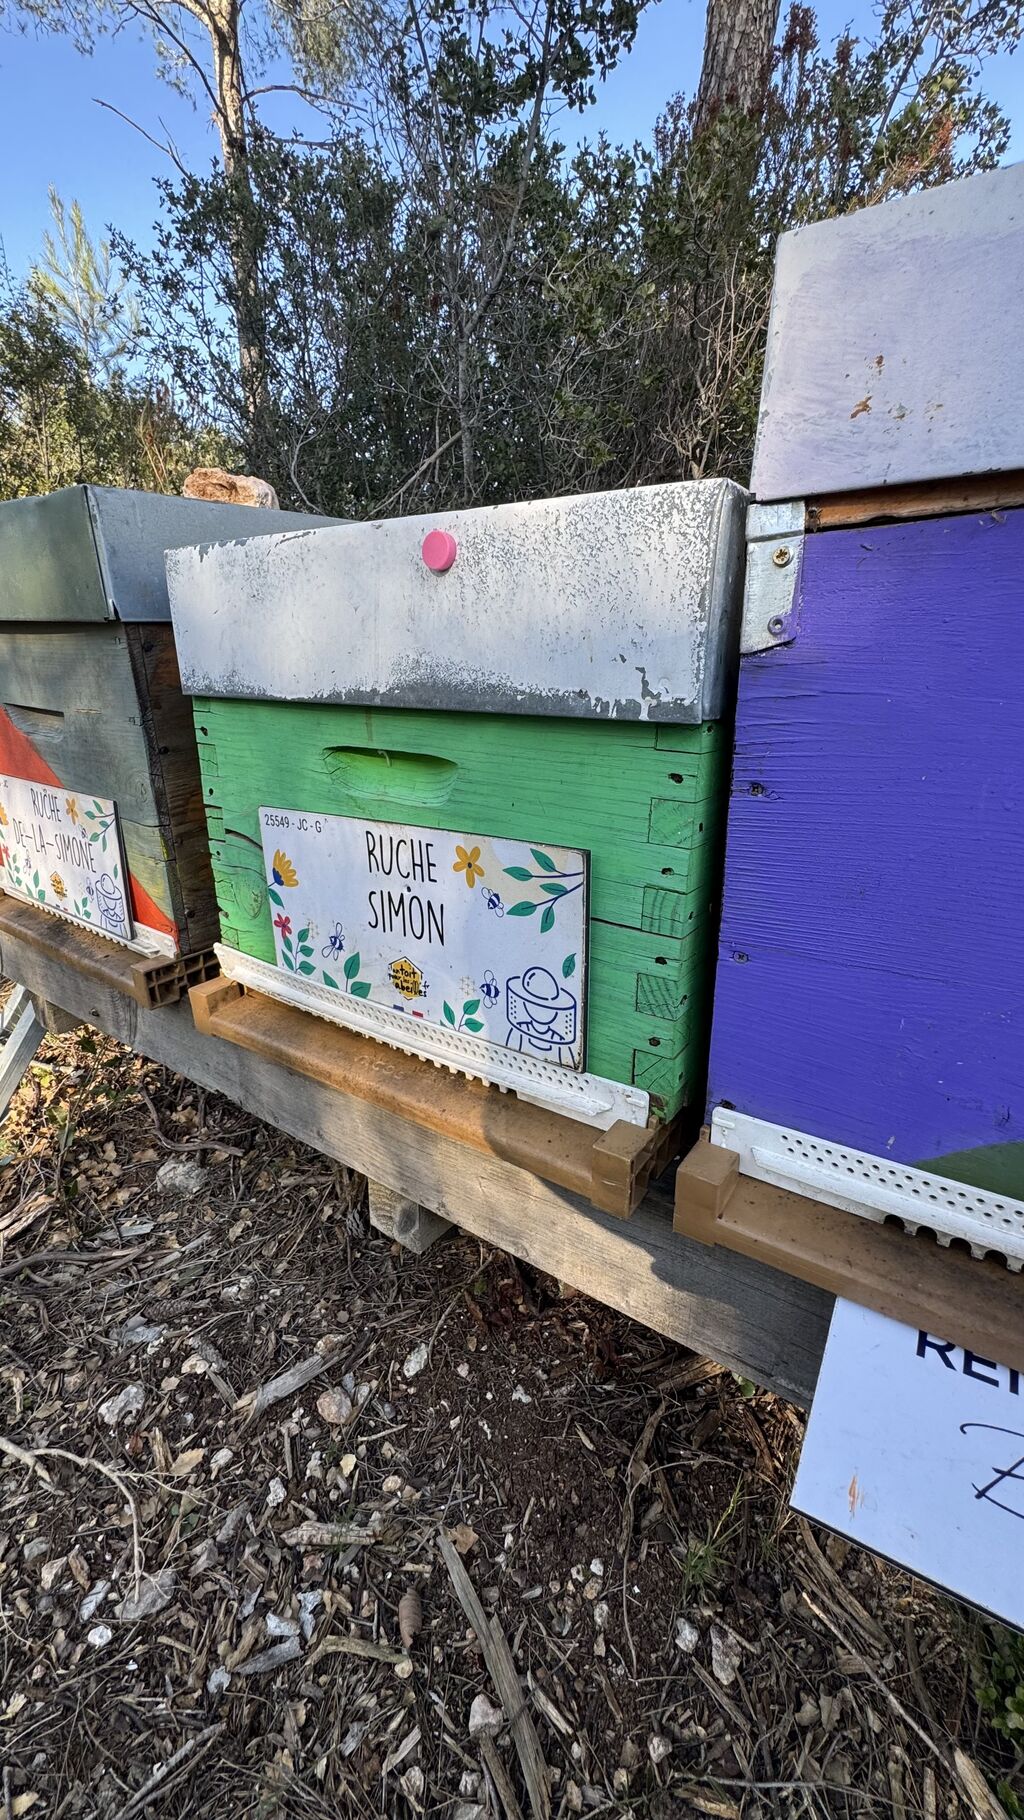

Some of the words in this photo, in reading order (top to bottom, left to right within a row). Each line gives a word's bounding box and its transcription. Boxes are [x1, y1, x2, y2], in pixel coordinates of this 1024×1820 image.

[30, 787, 62, 823] RUCHE
[12, 817, 97, 873] DE-LA-SIMONE
[366, 830, 438, 883] RUCHE
[367, 890, 445, 946] SIMON
